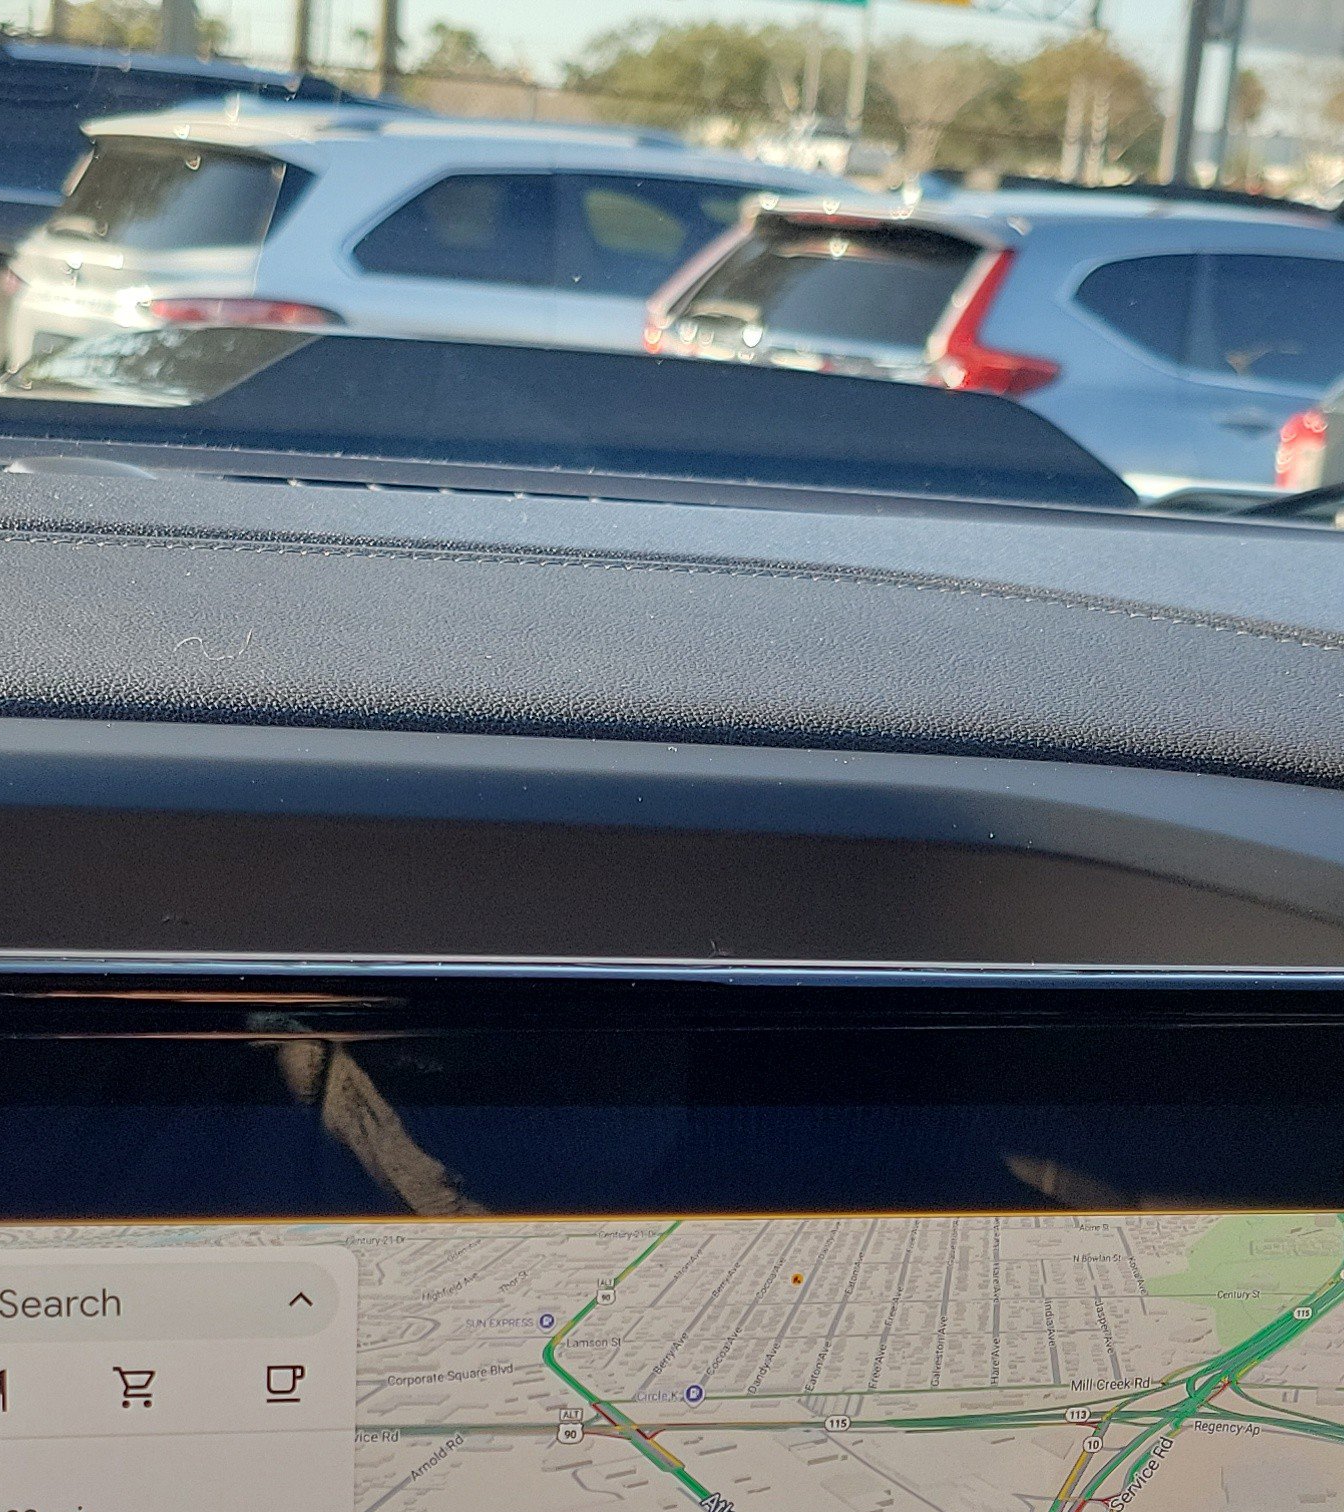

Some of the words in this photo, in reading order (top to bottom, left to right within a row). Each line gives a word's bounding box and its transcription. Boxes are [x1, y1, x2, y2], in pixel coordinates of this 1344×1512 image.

[346, 1235, 380, 1247] Century
[382, 1234, 394, 1244] 21
[395, 1234, 406, 1244] Dr
[854, 1251, 865, 1269] Ave
[1073, 1254, 1080, 1263] N
[1112, 1253, 1122, 1263] St
[422, 1280, 462, 1302] Highfield
[462, 1271, 479, 1288] Ave
[499, 1276, 518, 1294] Thor
[711, 1277, 729, 1299] Berry
[726, 1261, 741, 1280] Ave
[756, 1272, 775, 1300] Cocoa
[772, 1257, 786, 1274] Ave
[1136, 1278, 1147, 1296] Ave
[601, 1293, 612, 1302] 90
[1216, 1289, 1250, 1301] Century
[1251, 1289, 1261, 1299] St
[884, 1302, 898, 1327] Free
[893, 1284, 904, 1304] Ave
[1296, 1308, 1310, 1318] 115
[465, 1318, 487, 1329] SUN
[488, 1317, 534, 1328] EXPRESS
[937, 1315, 948, 1335] Ave
[1094, 1299, 1108, 1335] Jasper
[1103, 1334, 1115, 1355] Ave
[566, 1338, 608, 1349] Lamson
[610, 1337, 622, 1348] St
[1047, 1326, 1056, 1347] Ave
[654, 1347, 677, 1375] Berry
[673, 1332, 688, 1351] Ave
[707, 1344, 730, 1376] Cocoa
[726, 1325, 742, 1347] Ave
[874, 1343, 887, 1366] Ave
[991, 1337, 1001, 1359] Ave
[748, 1361, 770, 1395] Dandy
[766, 1341, 781, 1363] Ave
[806, 1360, 823, 1392] Eaton
[818, 1340, 832, 1362] Ave
[930, 1335, 945, 1387] Galveston
[387, 1371, 444, 1389] Corporate
[446, 1366, 488, 1385] Square
[490, 1362, 514, 1377] Blvd
[868, 1365, 882, 1390] Free
[990, 1358, 1001, 1386] Hare
[1071, 1379, 1094, 1392] Mill
[1096, 1378, 1131, 1391] Creek
[1134, 1377, 1151, 1390] Rd
[638, 1389, 670, 1402] Circle
[671, 1390, 680, 1401] K
[562, 1410, 579, 1420] ALT
[828, 1418, 848, 1429] 115
[1069, 1409, 1088, 1420] 113
[382, 1430, 399, 1443] Rd
[564, 1430, 577, 1440] 90
[1194, 1420, 1243, 1436] Regency
[1087, 1439, 1100, 1450] 10
[1152, 1436, 1174, 1459] Rd
[410, 1449, 448, 1482] Arnold
[446, 1435, 465, 1453] Rd
